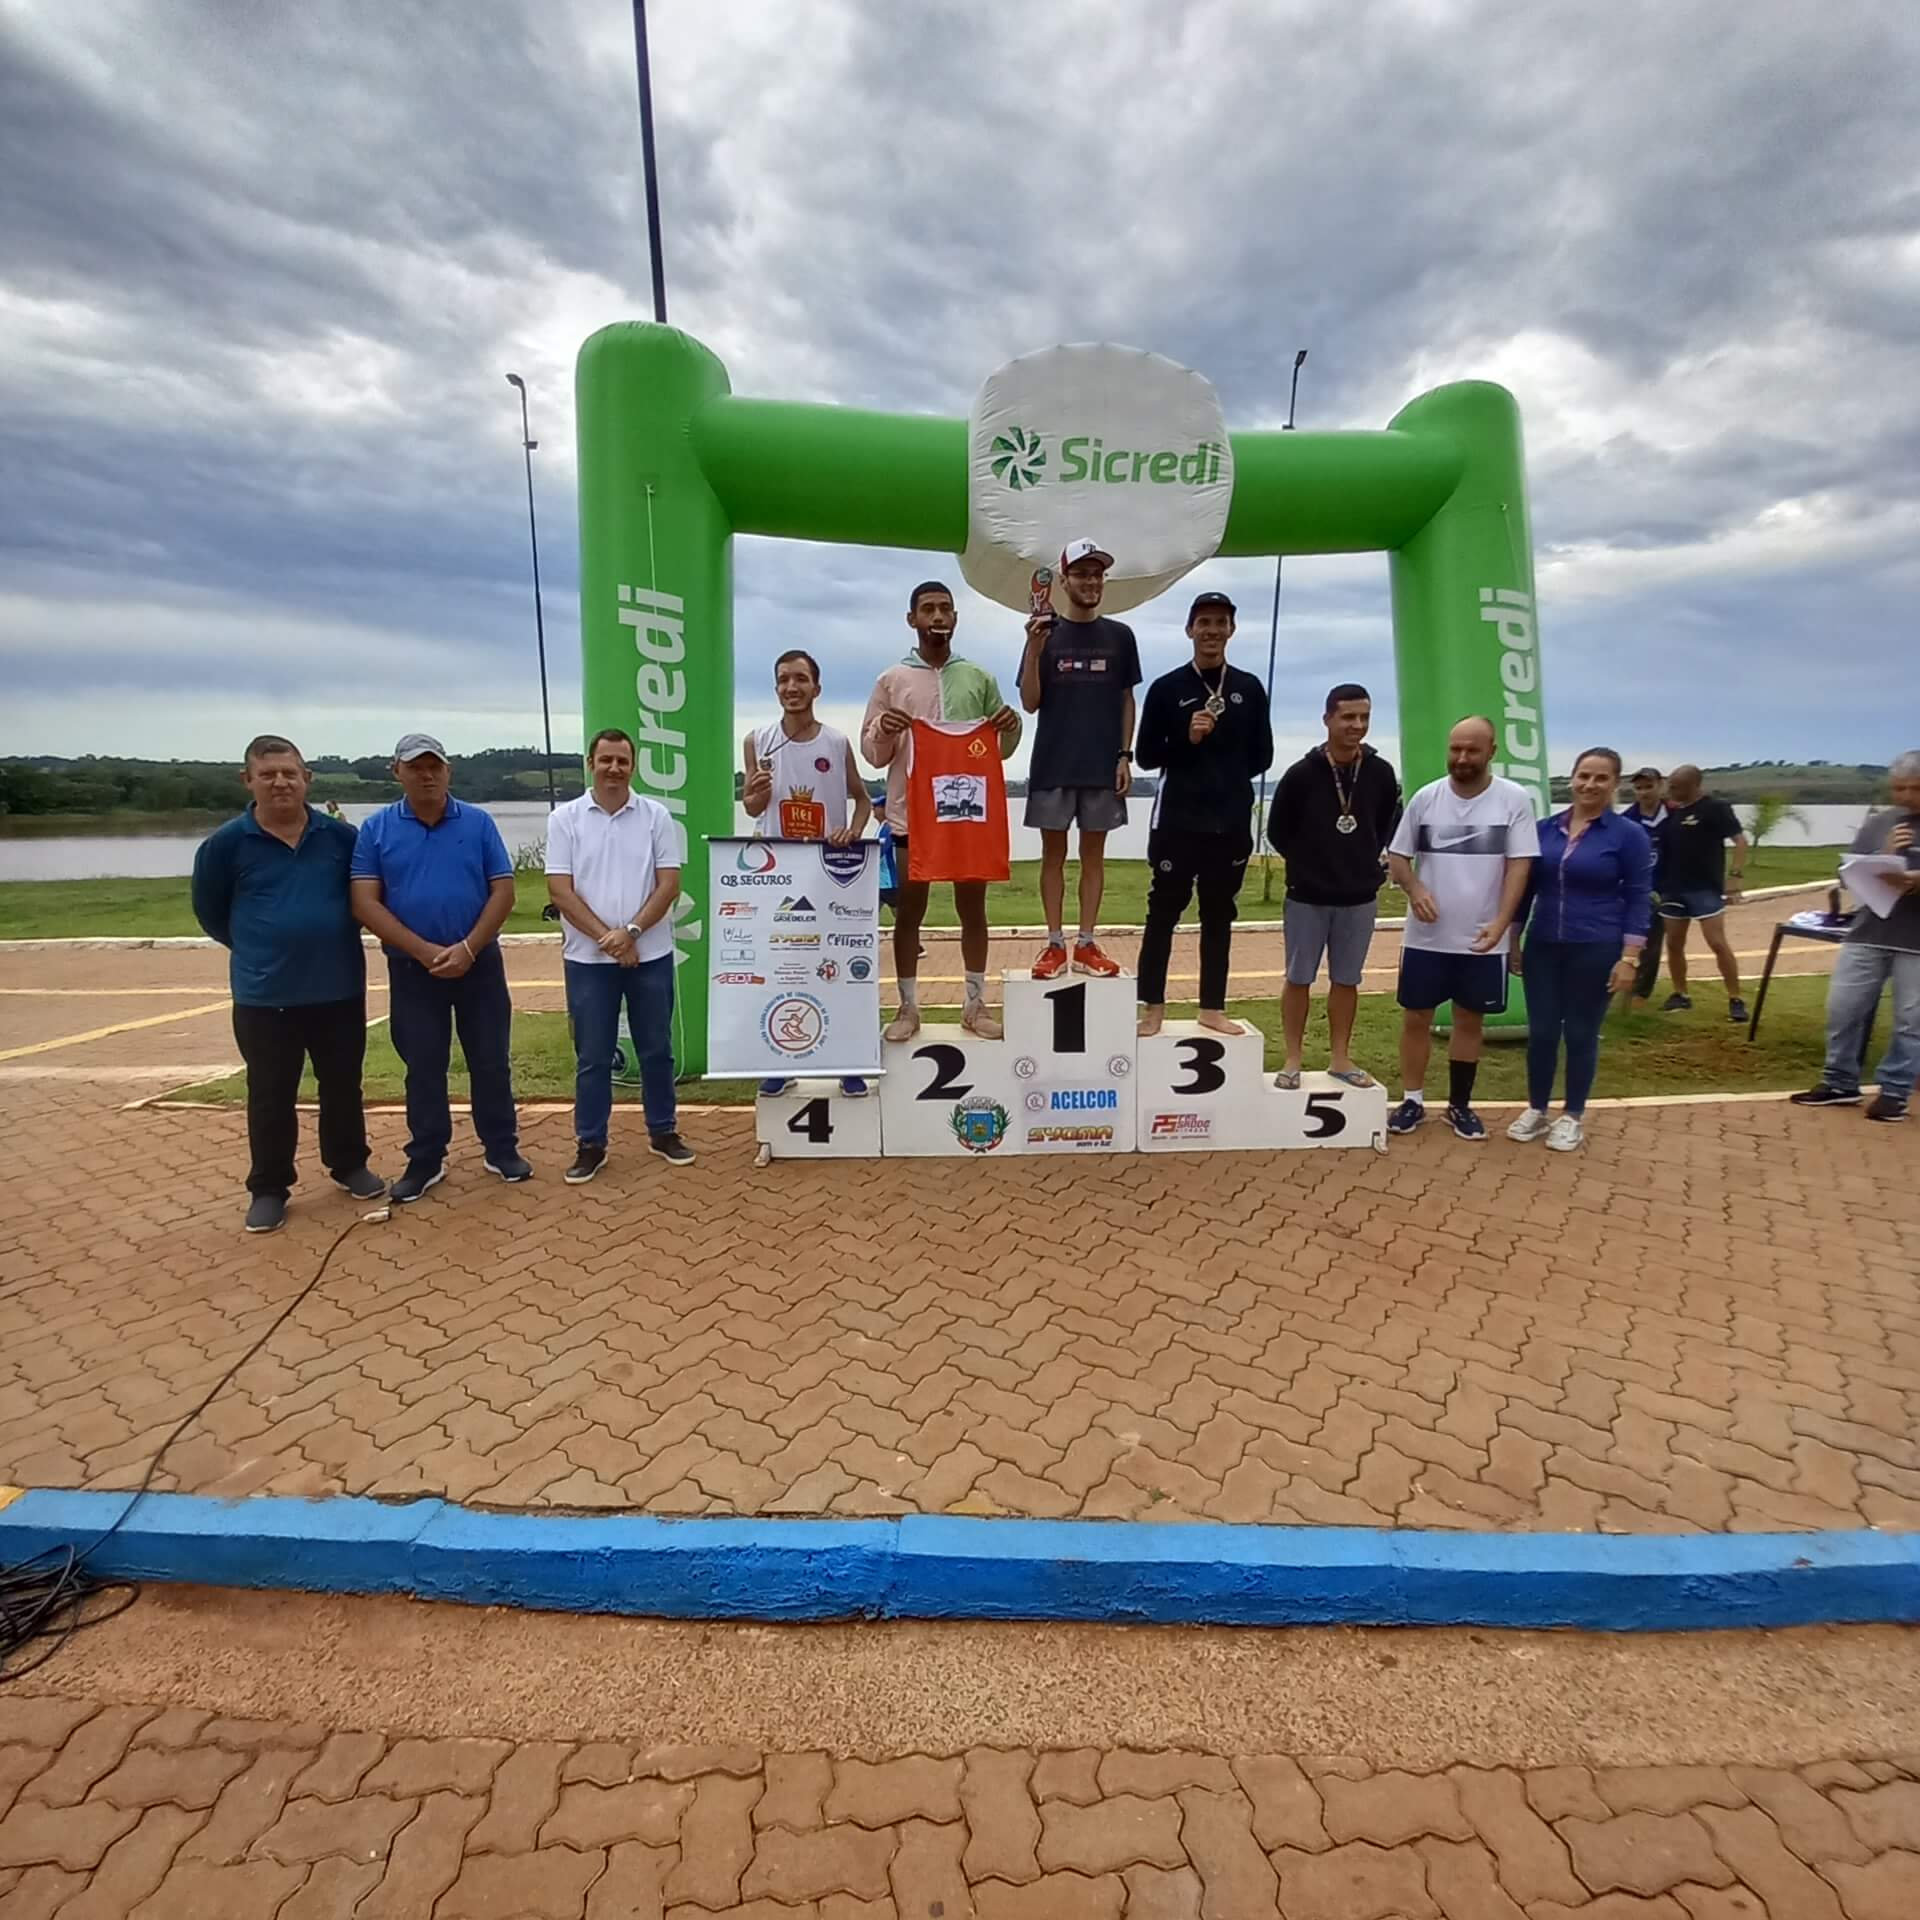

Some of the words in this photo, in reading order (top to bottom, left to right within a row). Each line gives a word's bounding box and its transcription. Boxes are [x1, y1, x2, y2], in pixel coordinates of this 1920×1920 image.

[1059, 437, 1222, 486] Sicredi
[740, 874, 793, 886] SEGUROS
[1045, 982, 1086, 1053] 1
[911, 1044, 974, 1101] 2
[1171, 1037, 1226, 1095] 3
[787, 1098, 834, 1144] 4
[1051, 1090, 1118, 1109] ACELCOR
[1303, 1092, 1346, 1138] 5
